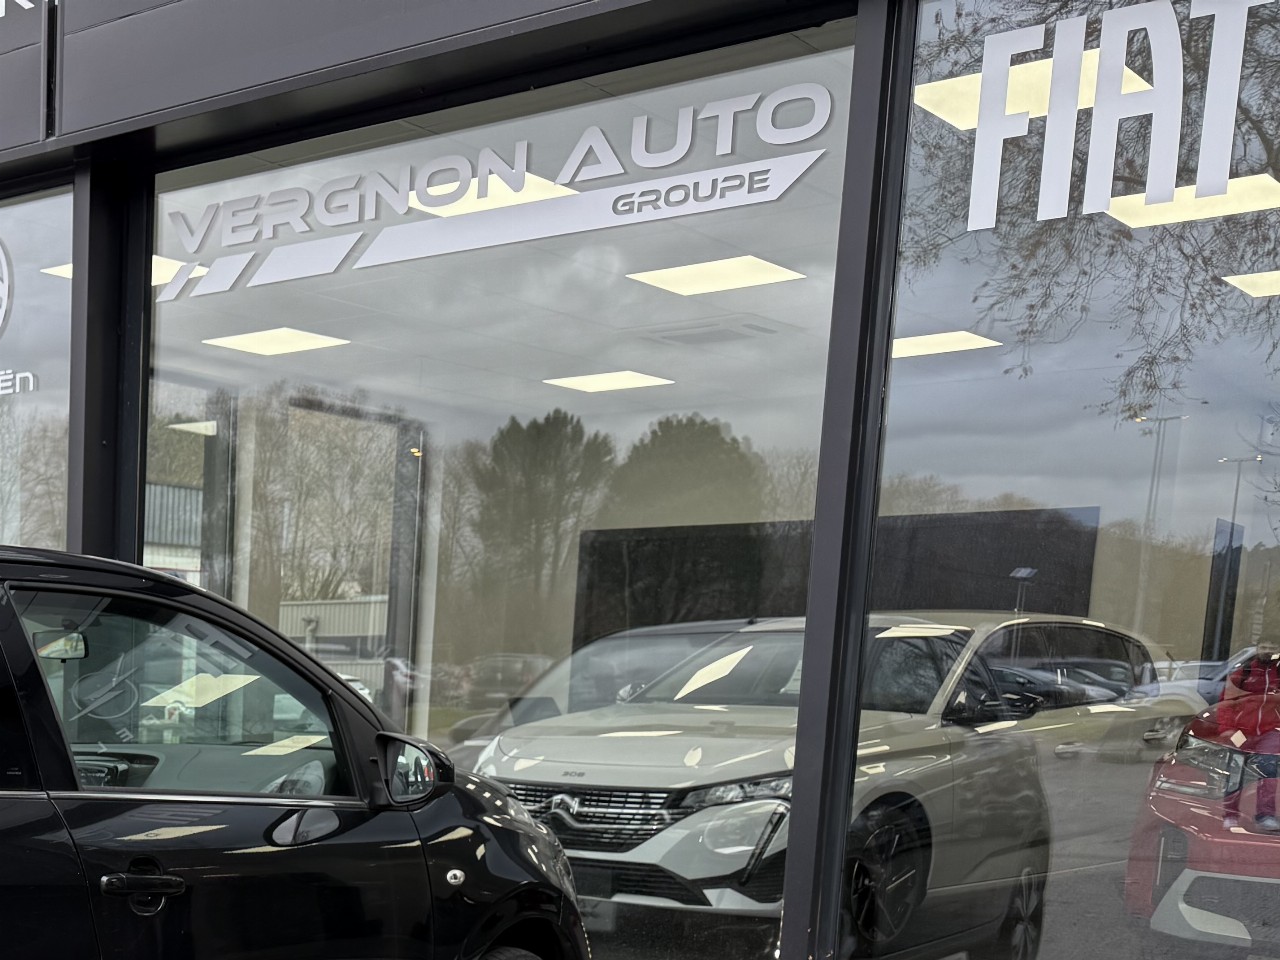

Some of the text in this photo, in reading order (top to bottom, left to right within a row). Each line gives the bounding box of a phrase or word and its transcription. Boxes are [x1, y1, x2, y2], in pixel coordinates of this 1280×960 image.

[168, 82, 832, 254] VERGNON AUTO
[611, 168, 772, 216] GROUPE
[967, 0, 1276, 231] FIAT
